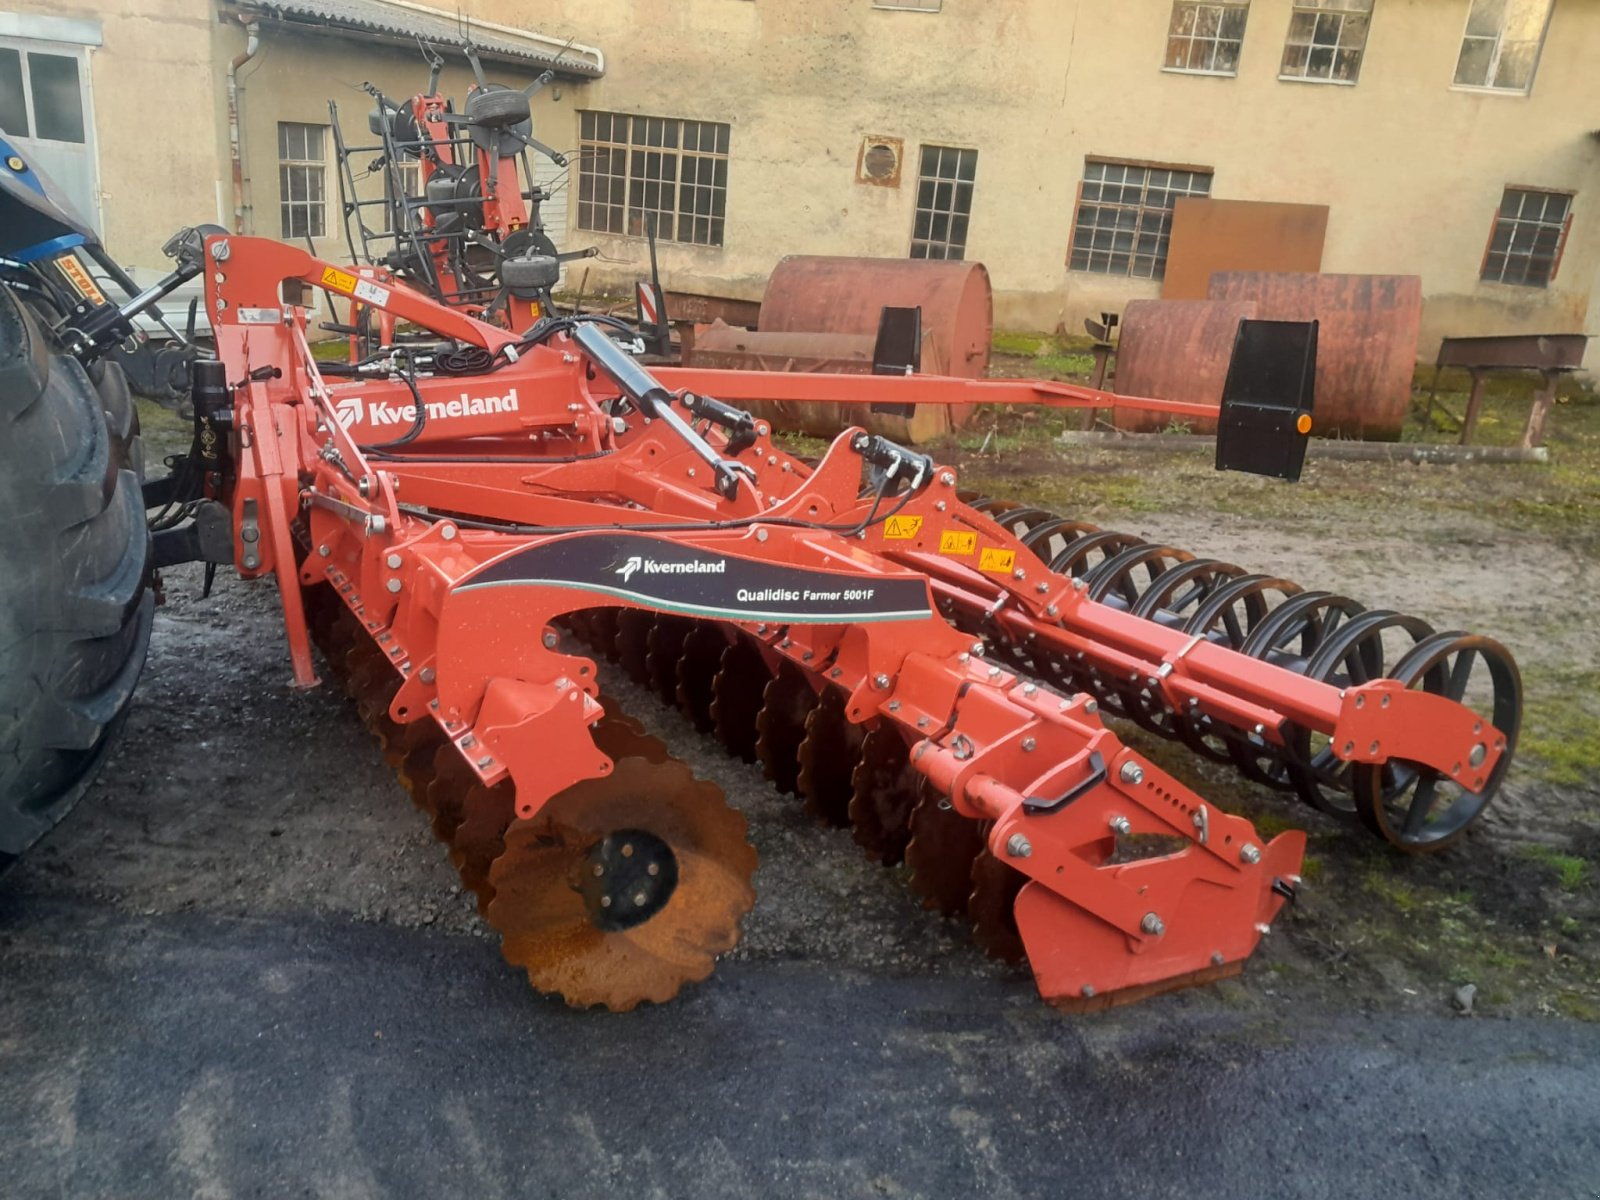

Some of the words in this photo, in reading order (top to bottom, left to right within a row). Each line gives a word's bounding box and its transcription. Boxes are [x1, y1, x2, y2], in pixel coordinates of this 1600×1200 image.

[368, 388, 519, 426] Kveneland
[643, 559, 726, 575] Kverneland
[736, 588, 800, 603] Qualidisc
[803, 590, 841, 601] Farmer
[843, 589, 875, 601] 5001F
